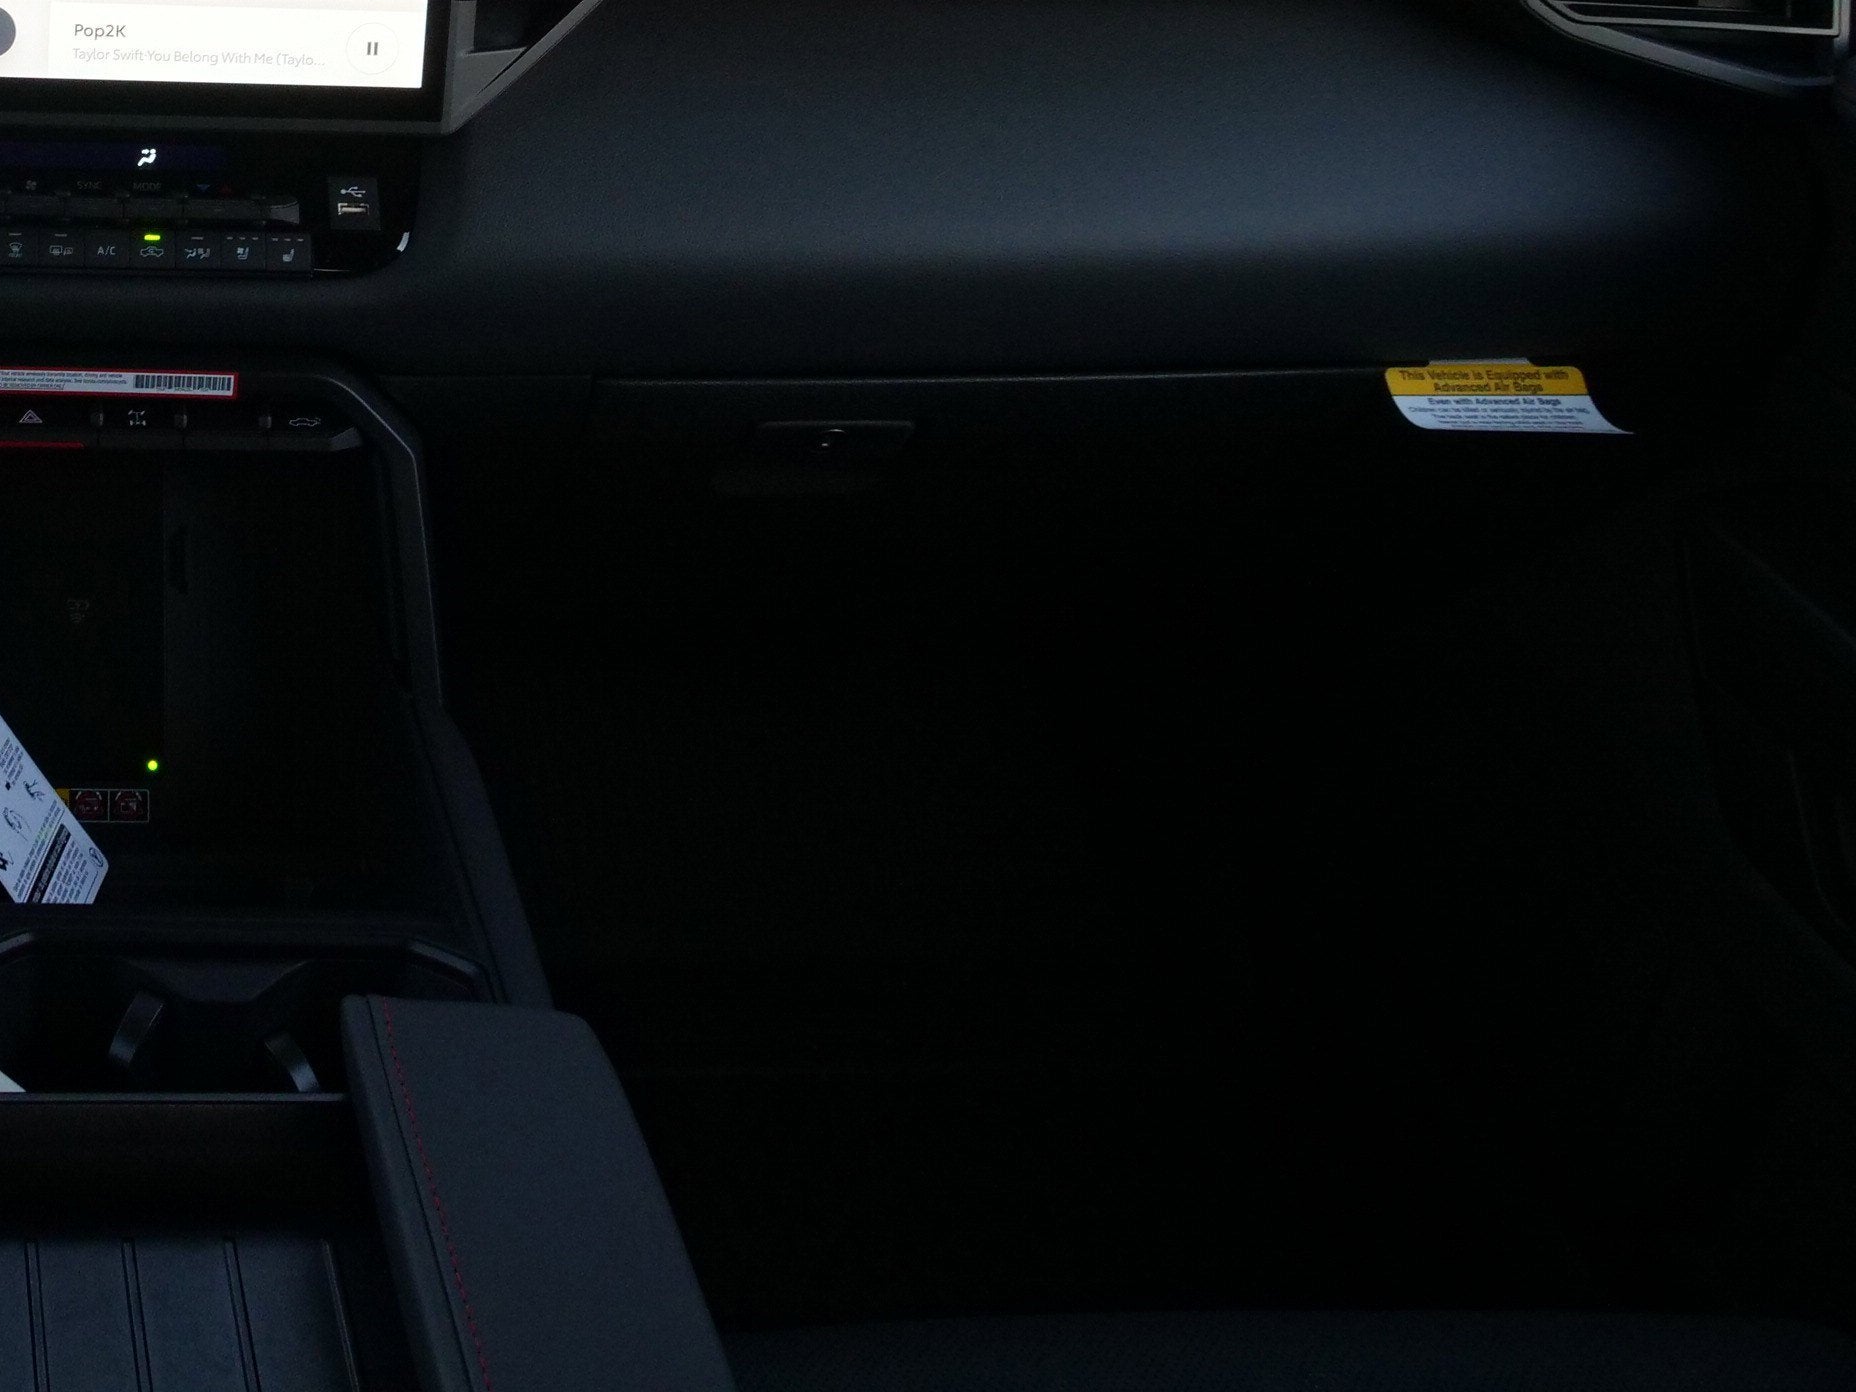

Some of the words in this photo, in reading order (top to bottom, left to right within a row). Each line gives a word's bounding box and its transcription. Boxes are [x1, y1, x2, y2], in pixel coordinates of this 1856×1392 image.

[73, 23, 128, 41] Pop2K
[72, 47, 110, 63] Taylor
[173, 50, 219, 66] Belong
[221, 51, 252, 65] With
[253, 53, 275, 65] Me
[76, 180, 104, 192] SYNC
[132, 181, 163, 192] MODE
[96, 245, 117, 257] A/C
[1399, 369, 1426, 381] This
[1427, 369, 1470, 381] Vehicle
[1485, 369, 1541, 384] Equipped
[1542, 369, 1569, 381] with
[1434, 381, 1491, 393] Advanced
[1494, 381, 1511, 393] Air
[1513, 381, 1544, 394] Bags
[1427, 397, 1452, 406] Even
[1453, 397, 1474, 406] with
[1475, 397, 1521, 406] Advanced
[1522, 397, 1535, 406] Air
[1536, 397, 1562, 408] Bags
